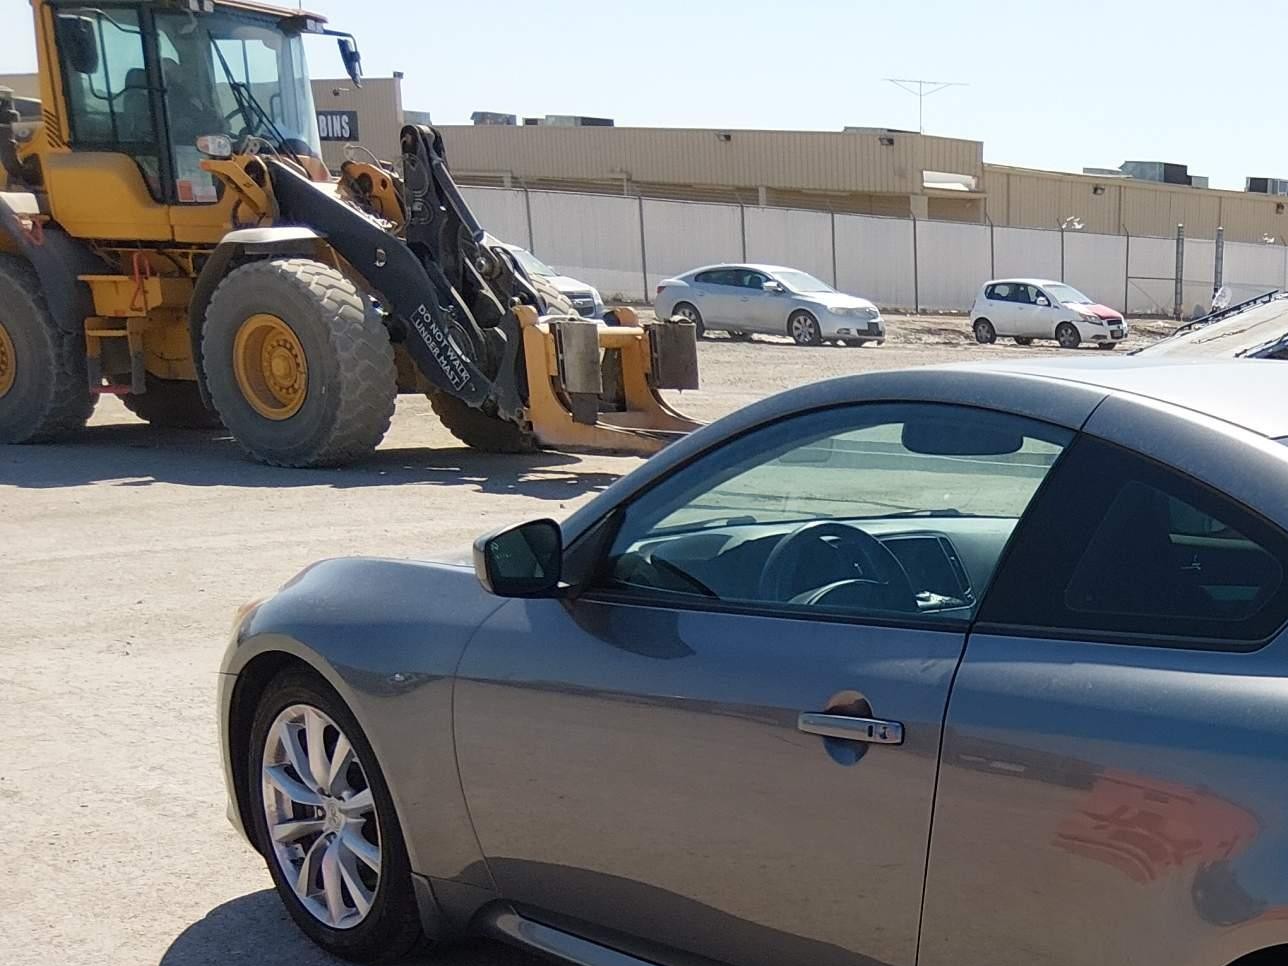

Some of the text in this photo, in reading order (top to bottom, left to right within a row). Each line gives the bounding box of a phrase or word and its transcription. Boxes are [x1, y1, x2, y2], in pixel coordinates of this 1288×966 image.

[415, 319, 460, 385] UNDER MAST
[418, 304, 471, 381] DO NOT WALK
